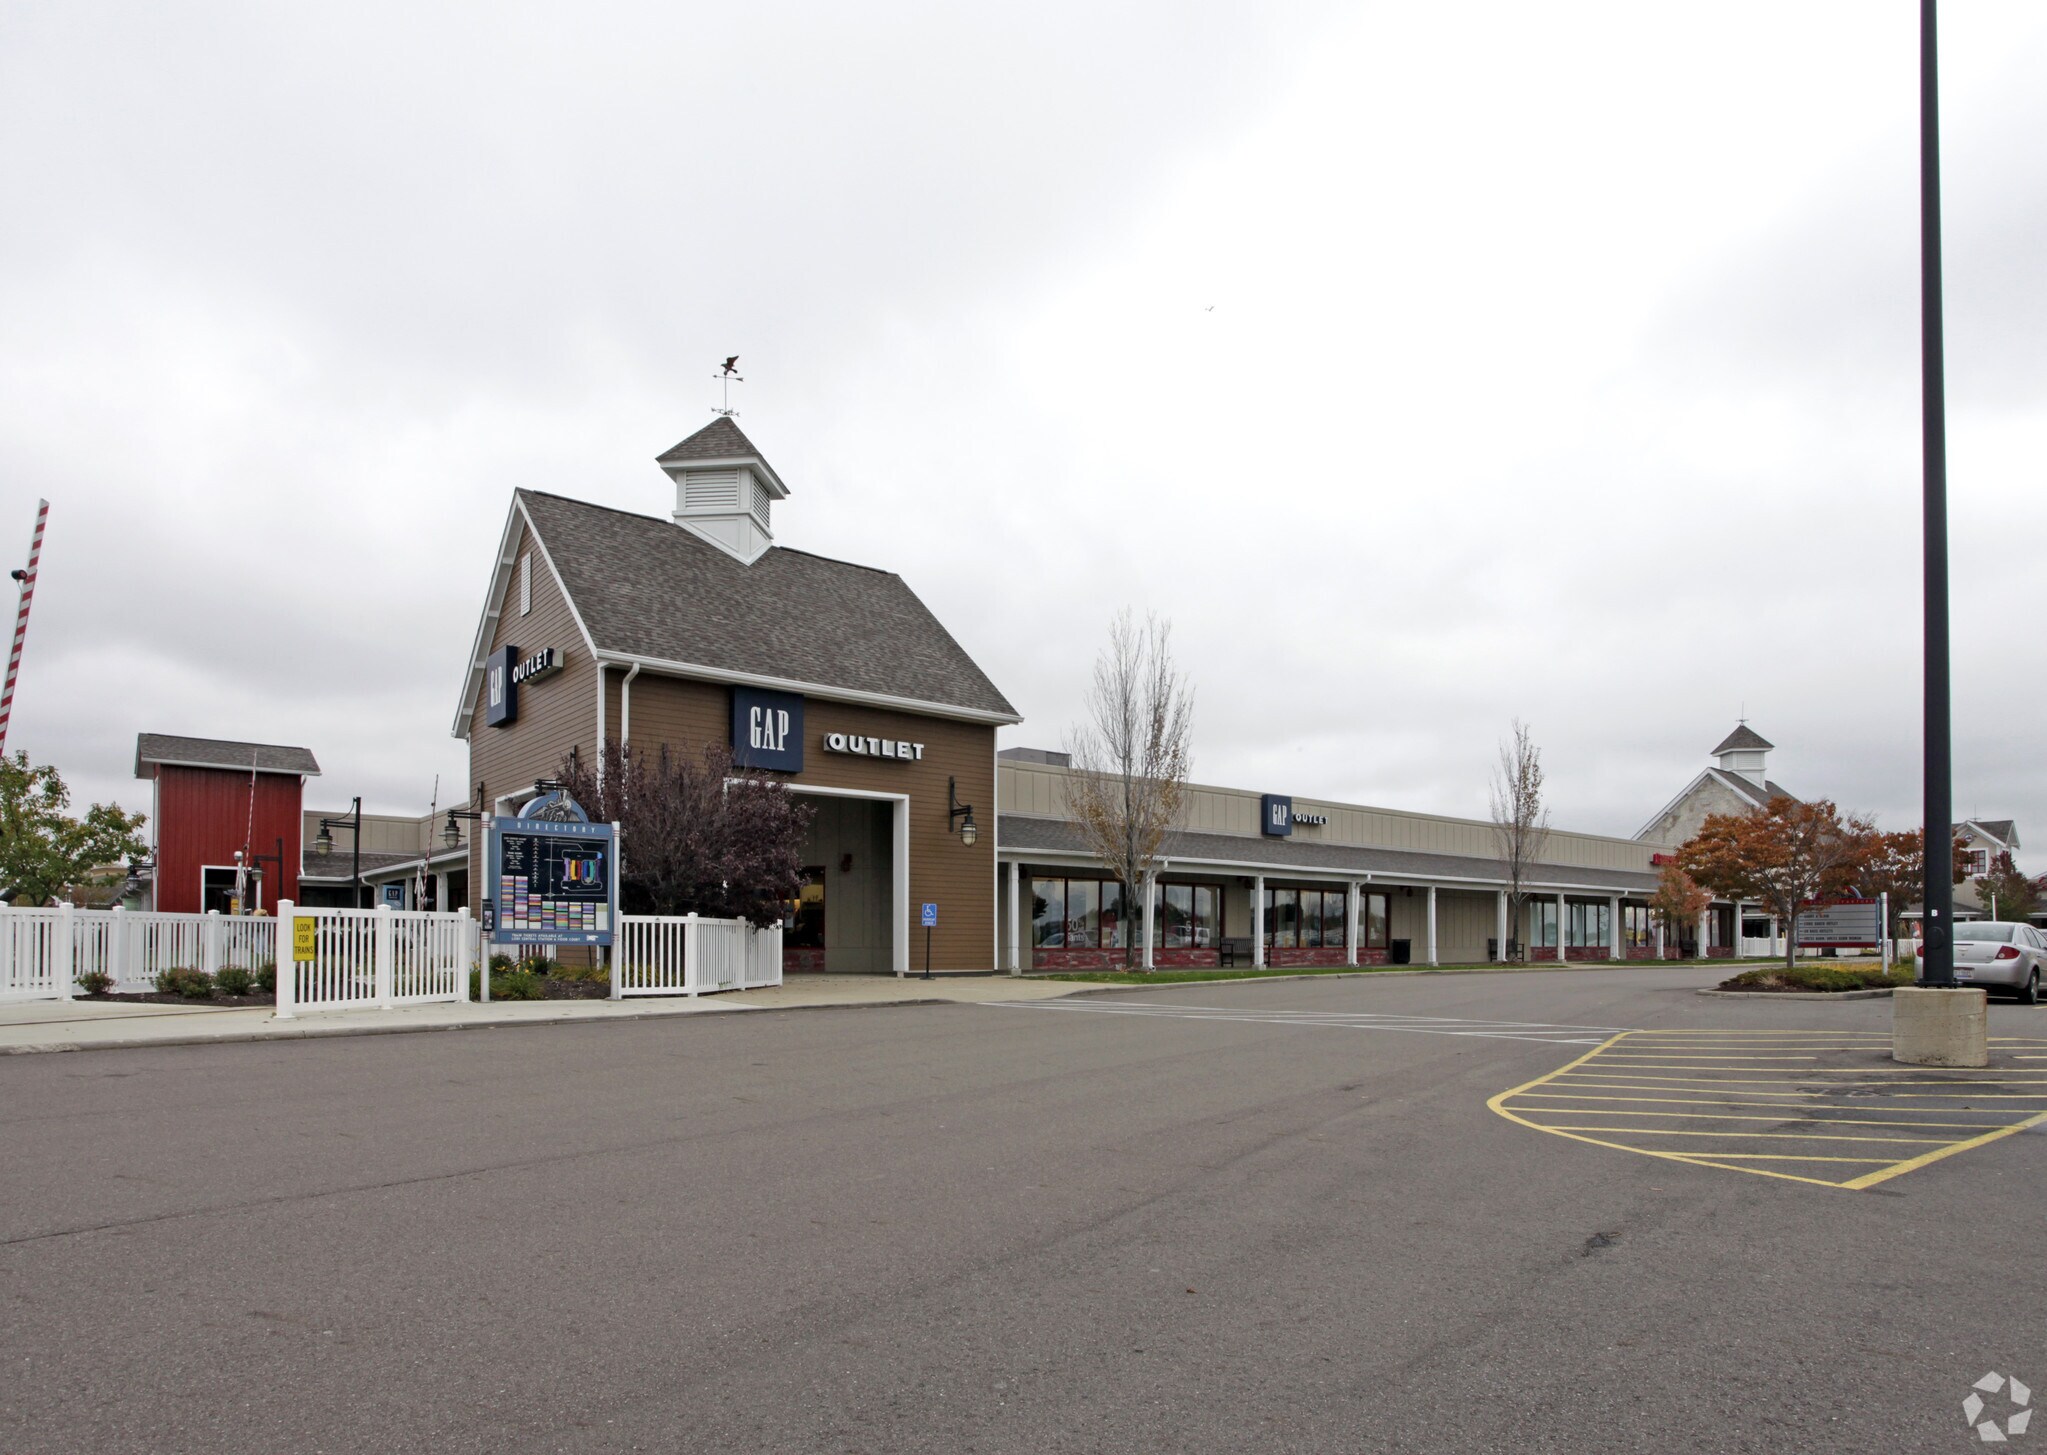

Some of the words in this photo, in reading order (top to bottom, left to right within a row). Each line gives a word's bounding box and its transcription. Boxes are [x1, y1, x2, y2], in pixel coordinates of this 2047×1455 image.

[490, 666, 503, 707] GAP
[512, 648, 549, 683] OUTLET
[750, 706, 789, 751] GAP
[828, 733, 925, 760] OUTLET
[1272, 804, 1287, 825] GAP
[1295, 813, 1328, 824] OUTLET
[517, 822, 596, 833] DIRECTORY
[296, 923, 311, 932] LOOK
[298, 934, 310, 943] FOR
[294, 946, 314, 954] TRAINS
